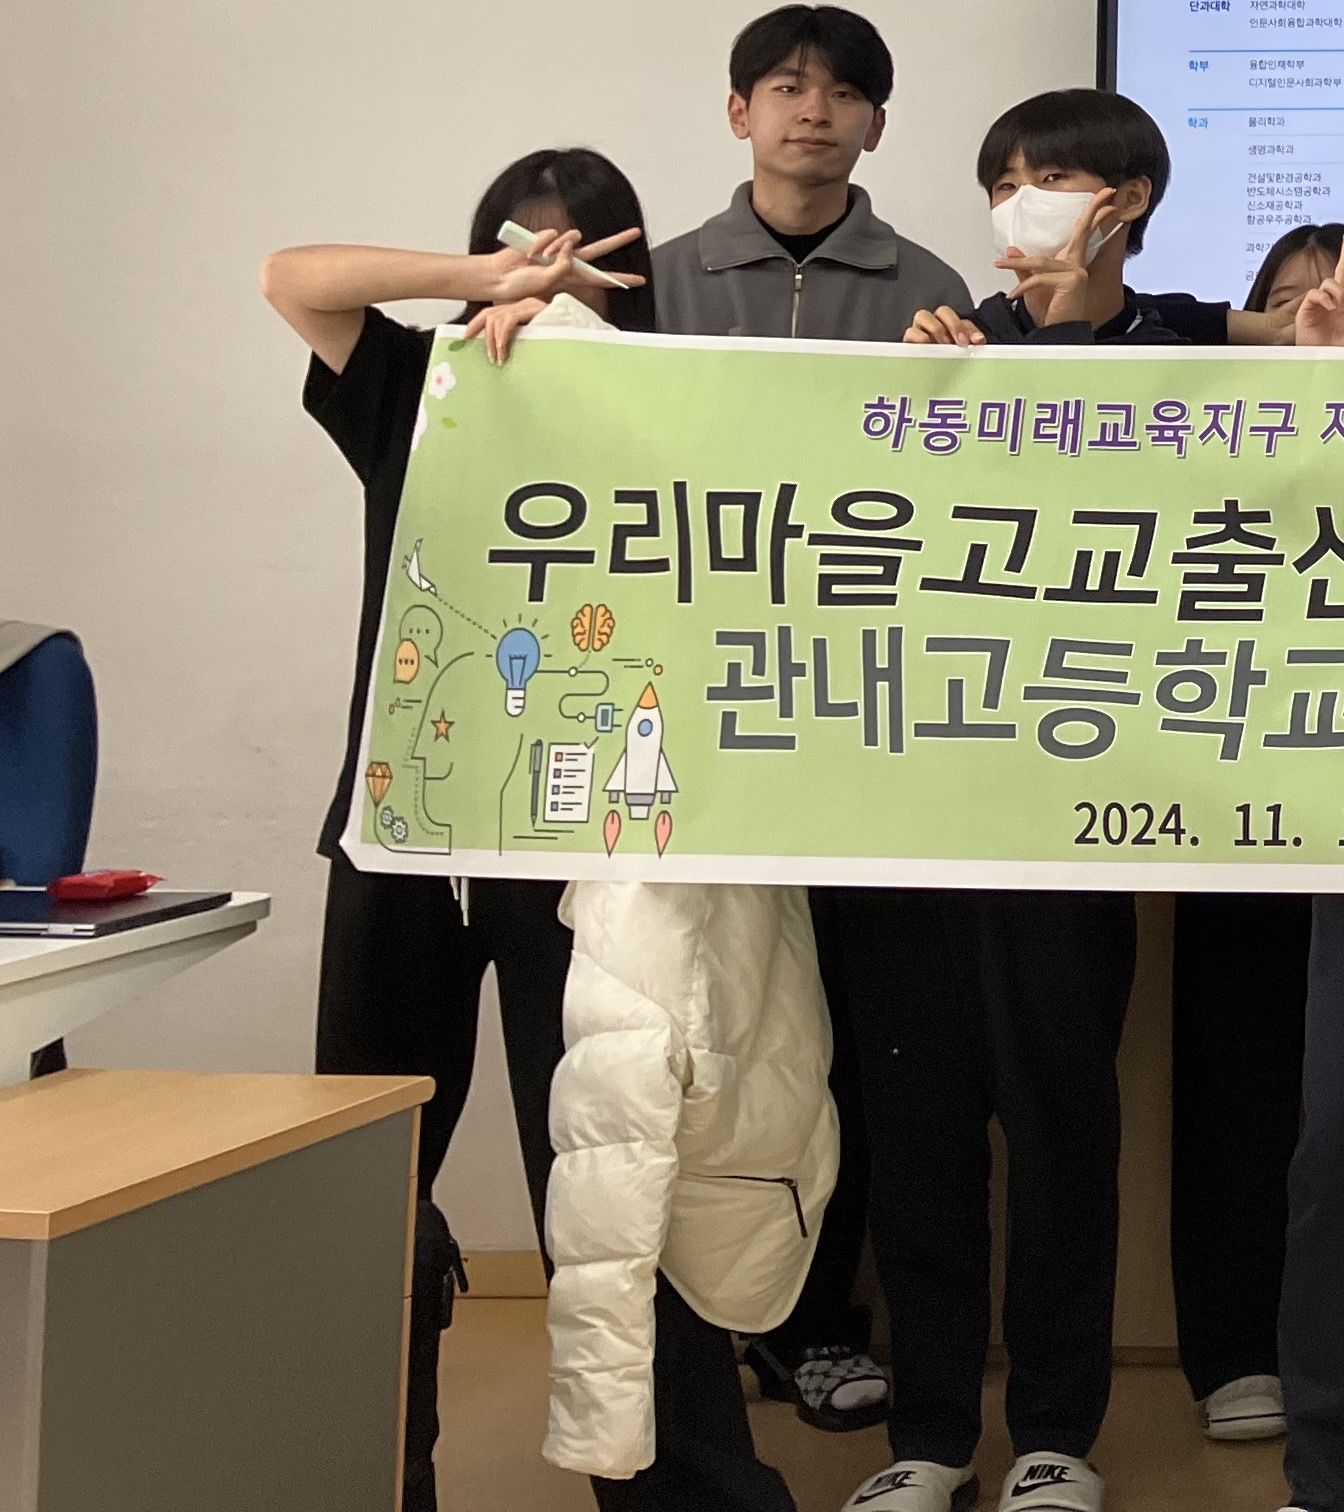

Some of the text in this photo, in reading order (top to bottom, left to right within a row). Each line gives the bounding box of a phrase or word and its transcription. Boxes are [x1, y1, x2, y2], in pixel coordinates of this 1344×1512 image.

[1189, 0, 1230, 12] 단과대학
[1249, 0, 1305, 11] 자연과학대학
[1188, 60, 1209, 72] 학부
[1188, 117, 1209, 129] 학과
[862, 394, 1299, 457] 하동미래교육지구
[1073, 800, 1200, 848] 2024.
[1233, 802, 1303, 849] 11.
[1023, 1464, 1071, 1482] NIKE
